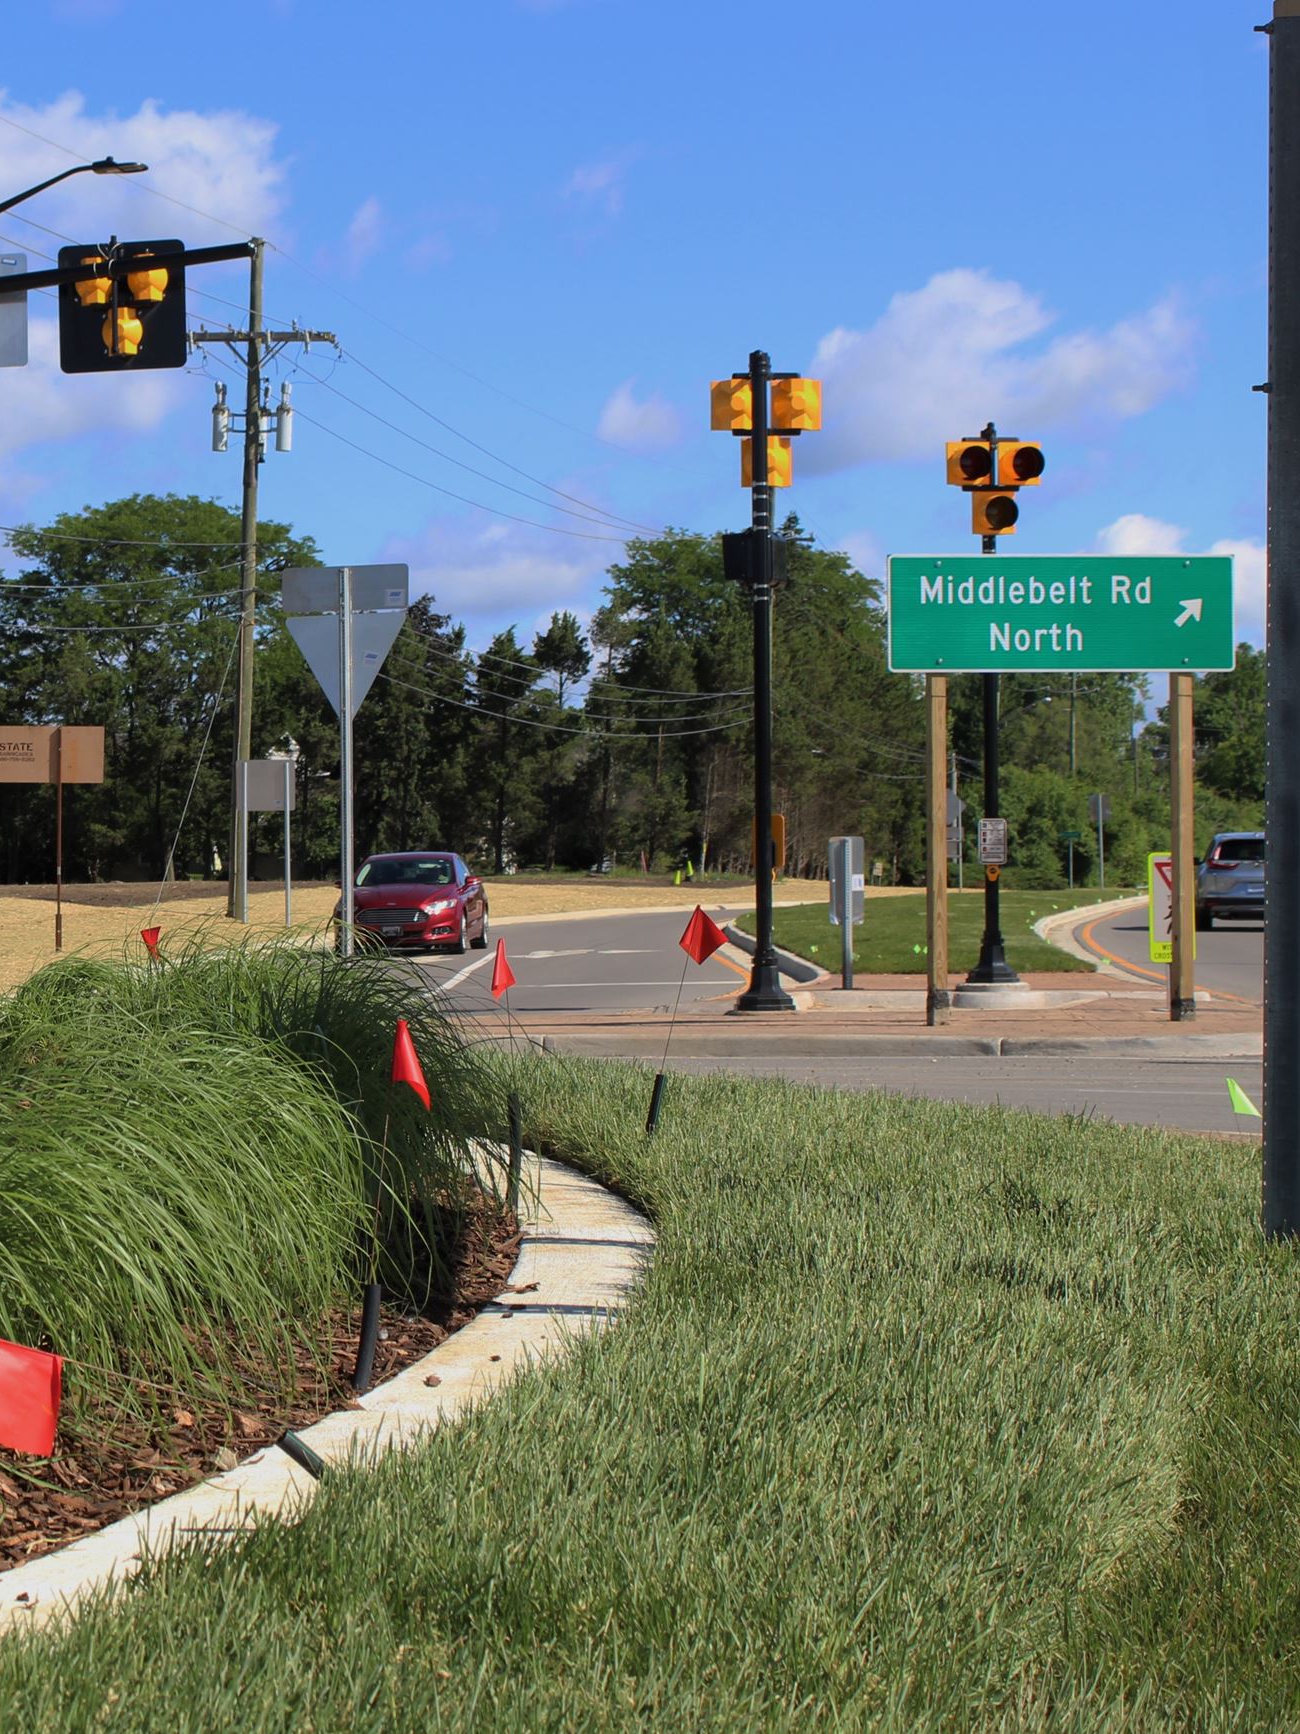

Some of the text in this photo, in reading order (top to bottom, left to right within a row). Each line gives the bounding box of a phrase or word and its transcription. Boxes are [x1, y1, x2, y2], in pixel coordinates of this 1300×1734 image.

[920, 575, 1151, 604] Middlebelt Rd
[990, 622, 1083, 651] North
[0, 742, 33, 751] STATE
